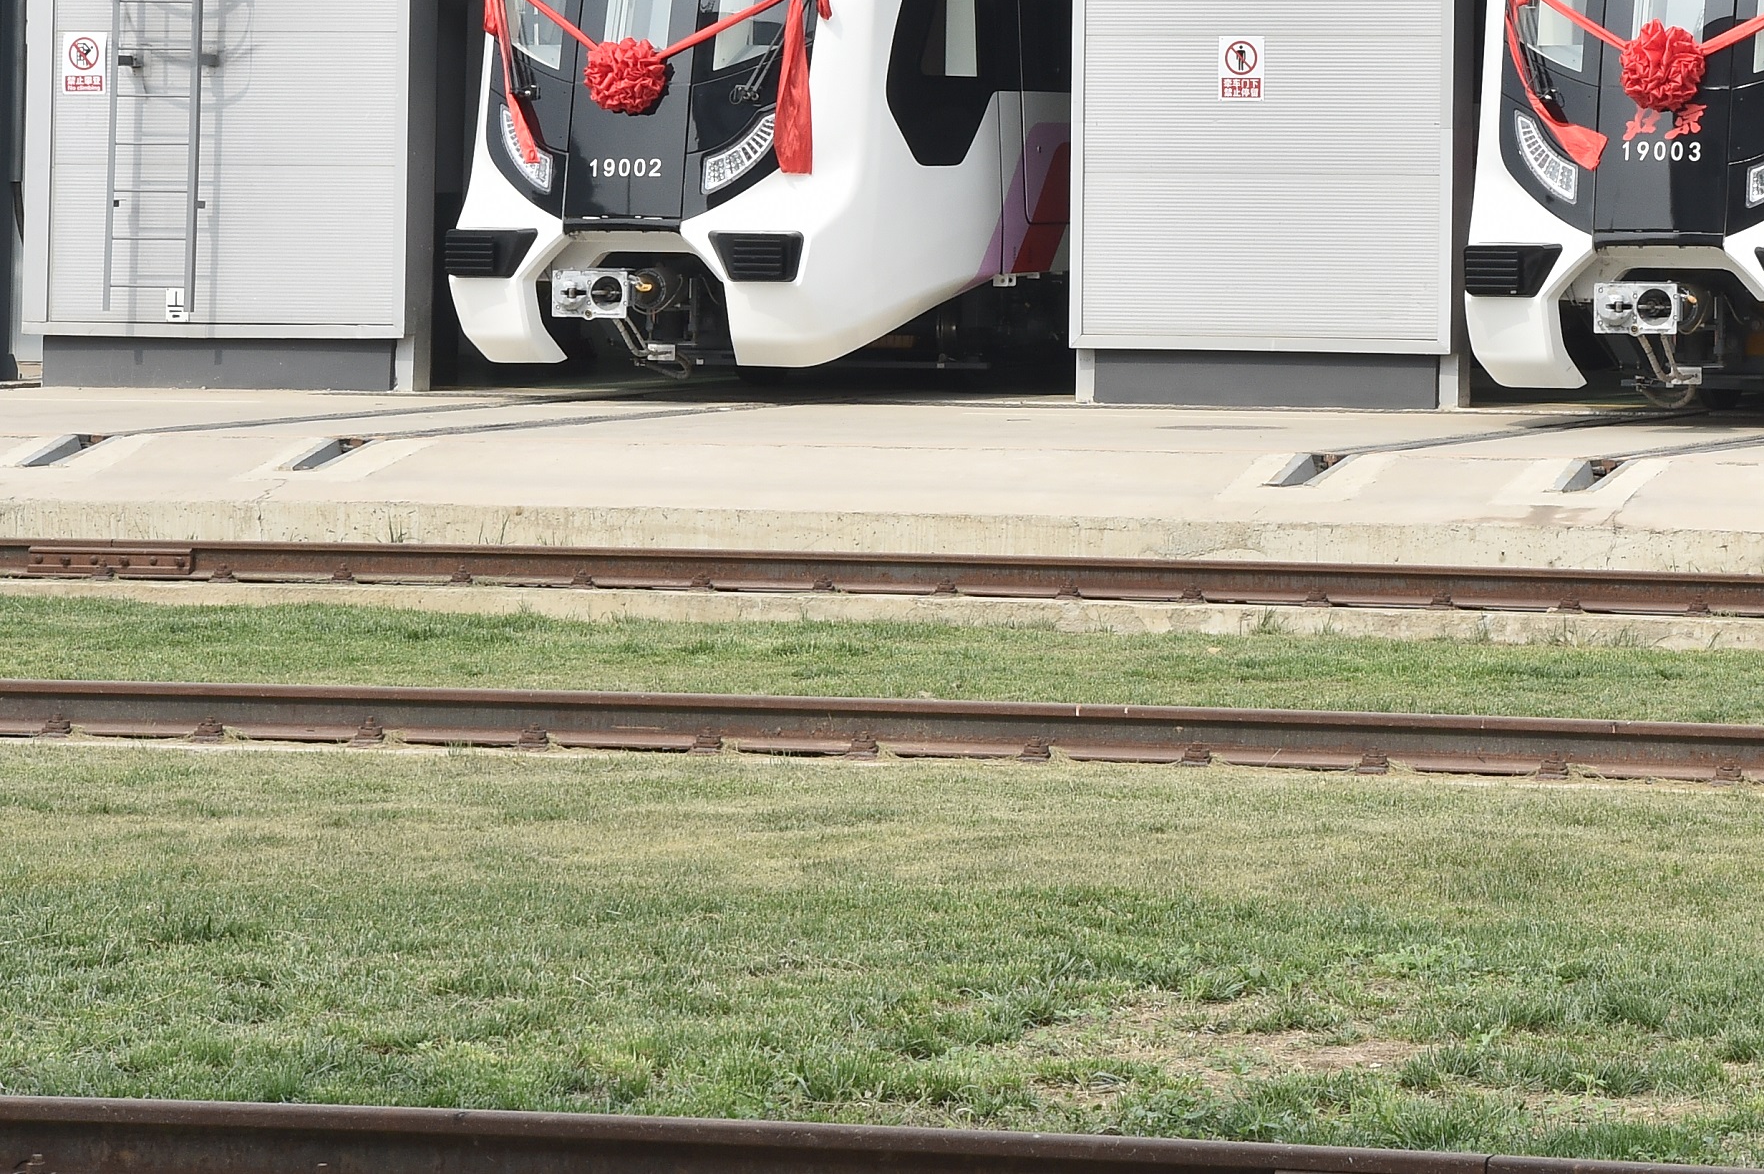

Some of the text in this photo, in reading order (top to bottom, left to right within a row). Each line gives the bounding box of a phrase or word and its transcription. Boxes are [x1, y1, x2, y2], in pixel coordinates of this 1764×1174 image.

[1223, 88, 1259, 97] 禁止停留
[1622, 104, 1708, 141] 北京
[1622, 141, 1702, 162] 19003
[589, 158, 662, 177] 19002
